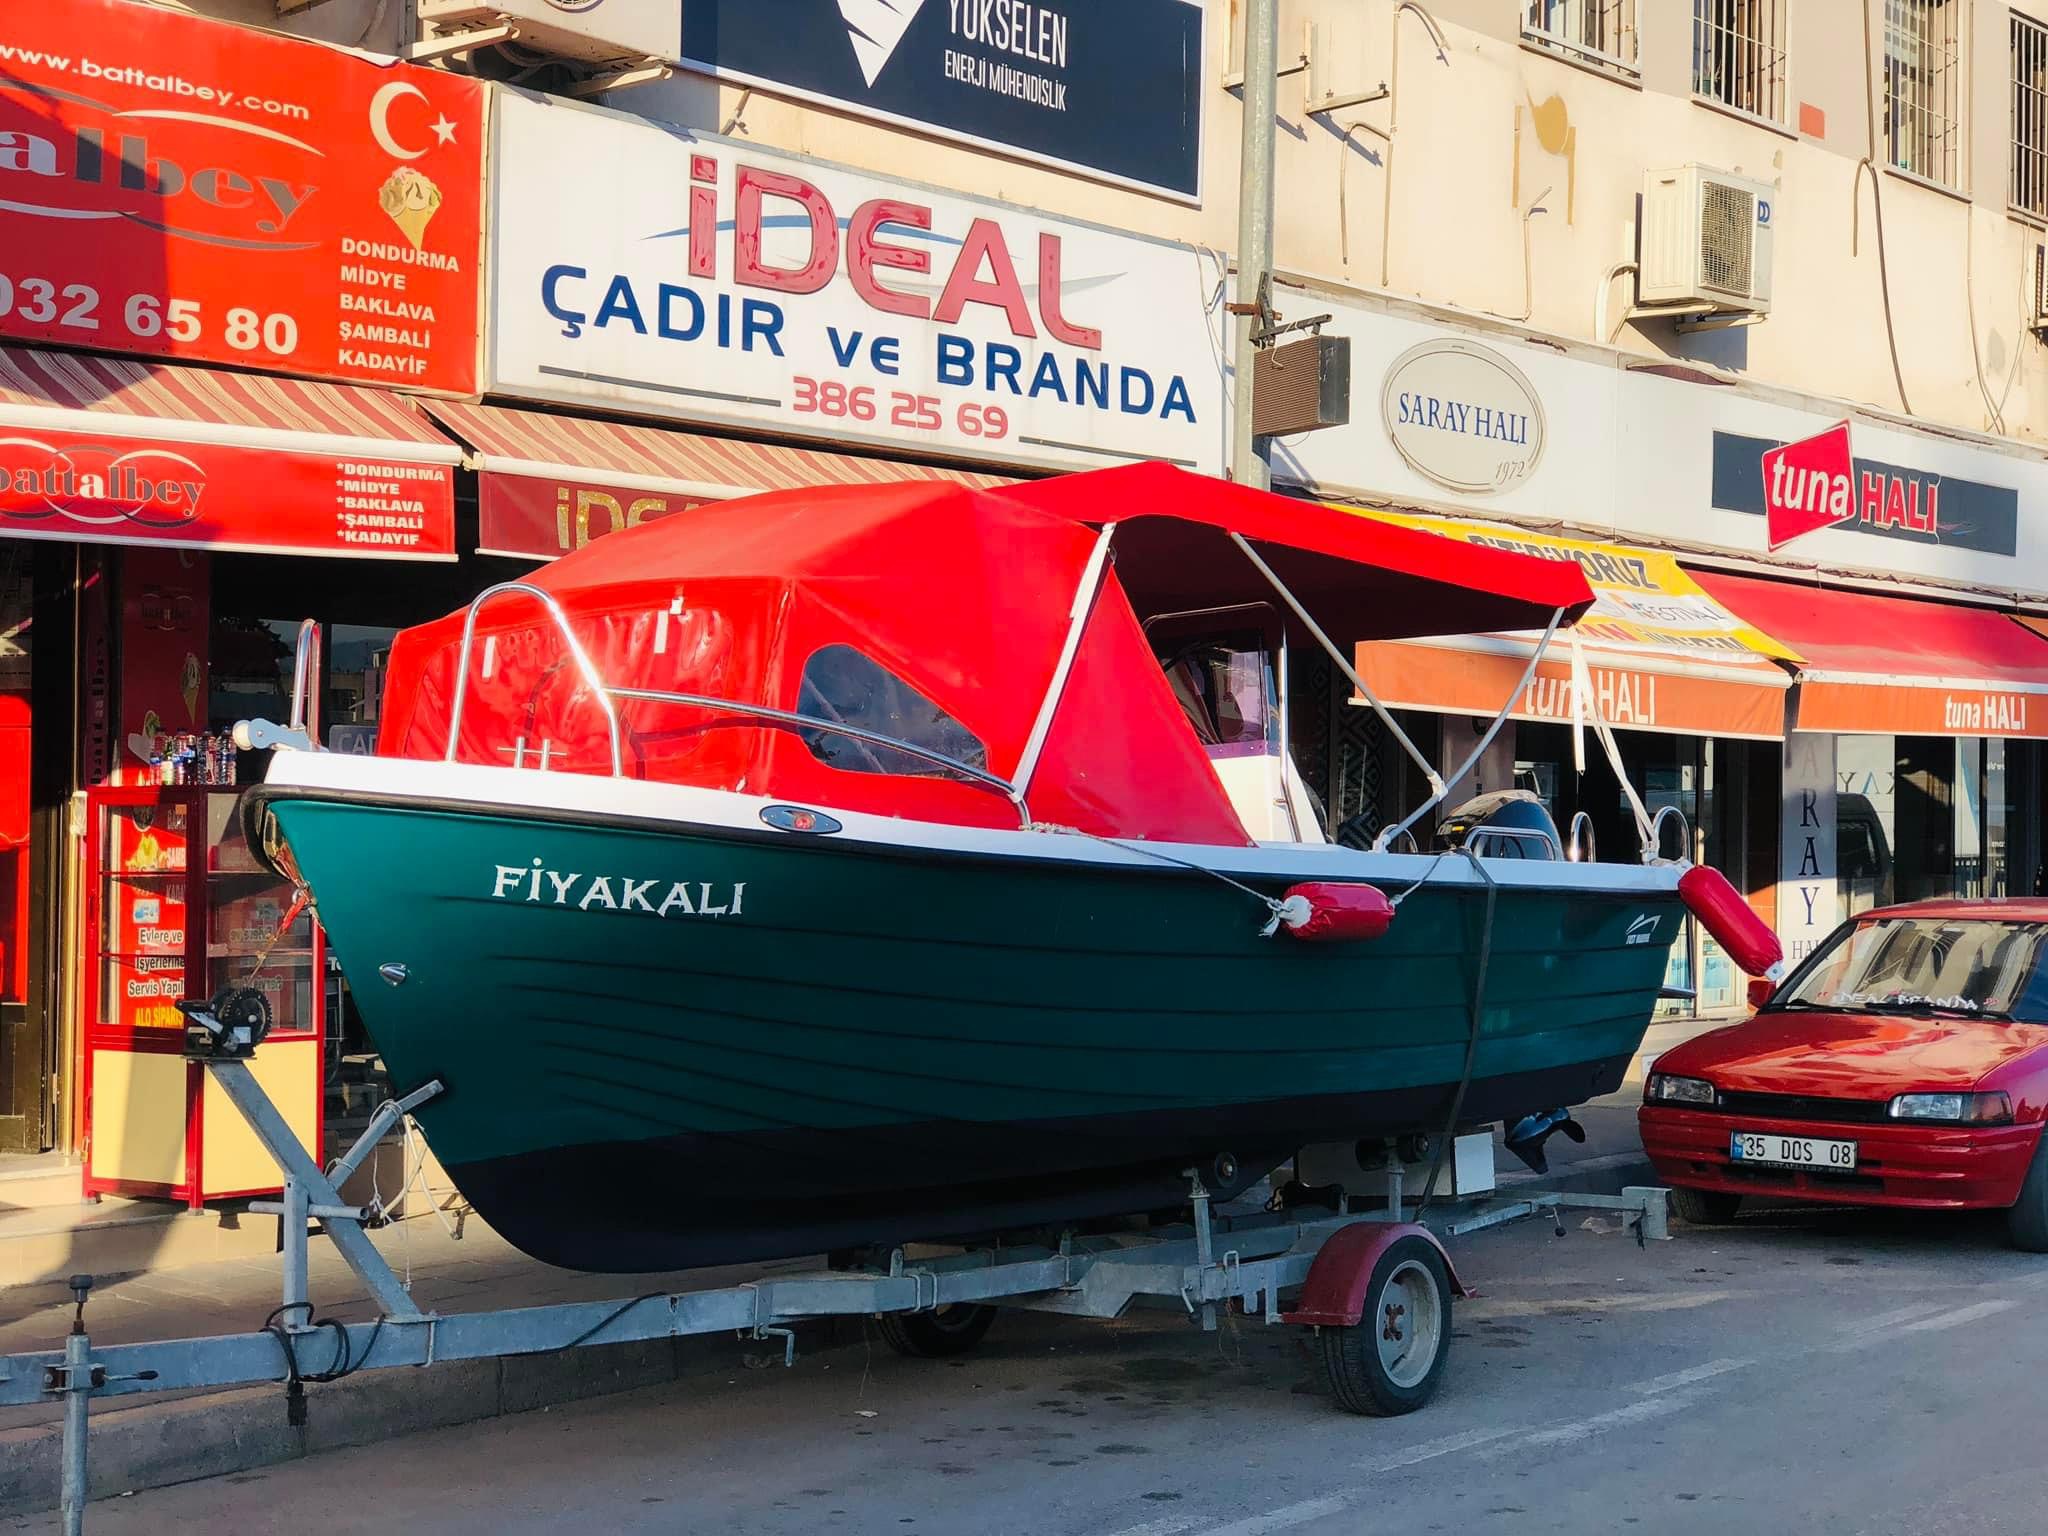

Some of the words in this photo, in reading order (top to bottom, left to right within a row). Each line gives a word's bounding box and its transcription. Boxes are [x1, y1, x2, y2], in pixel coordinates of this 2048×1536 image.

[944, 49, 986, 89] ENERJİ
[989, 62, 1066, 112] MÜHENDİSLİK
[341, 237, 460, 272] DONDURMA
[340, 264, 406, 290] MİDYE
[124, 293, 202, 342] 65
[224, 307, 298, 355] 80
[339, 293, 436, 323] BAKLAVA
[339, 320, 431, 349] ŞAMBALİ
[541, 264, 785, 357] ÇADIR
[937, 333, 1197, 423] BRANDA
[338, 348, 428, 375] KADAYİF
[793, 375, 876, 421] 386
[891, 391, 942, 430] 25
[957, 402, 1009, 439] 69
[1398, 392, 1470, 433] SARAY
[1474, 406, 1528, 444] HALI
[1495, 460, 1526, 486] 1972
[1771, 452, 1850, 517] tuna
[1859, 468, 1939, 535] HALI
[1597, 670, 1656, 725] HALI
[1945, 695, 1981, 729] tuna
[1983, 695, 2026, 730] HALI
[491, 857, 747, 919] FİYAKALI
[128, 980, 158, 997] Servis
[136, 1007, 151, 1026] ALO
[1745, 1136, 1765, 1157] 35
[1781, 1139, 1813, 1162] DOS
[1830, 1144, 1851, 1165] 08
